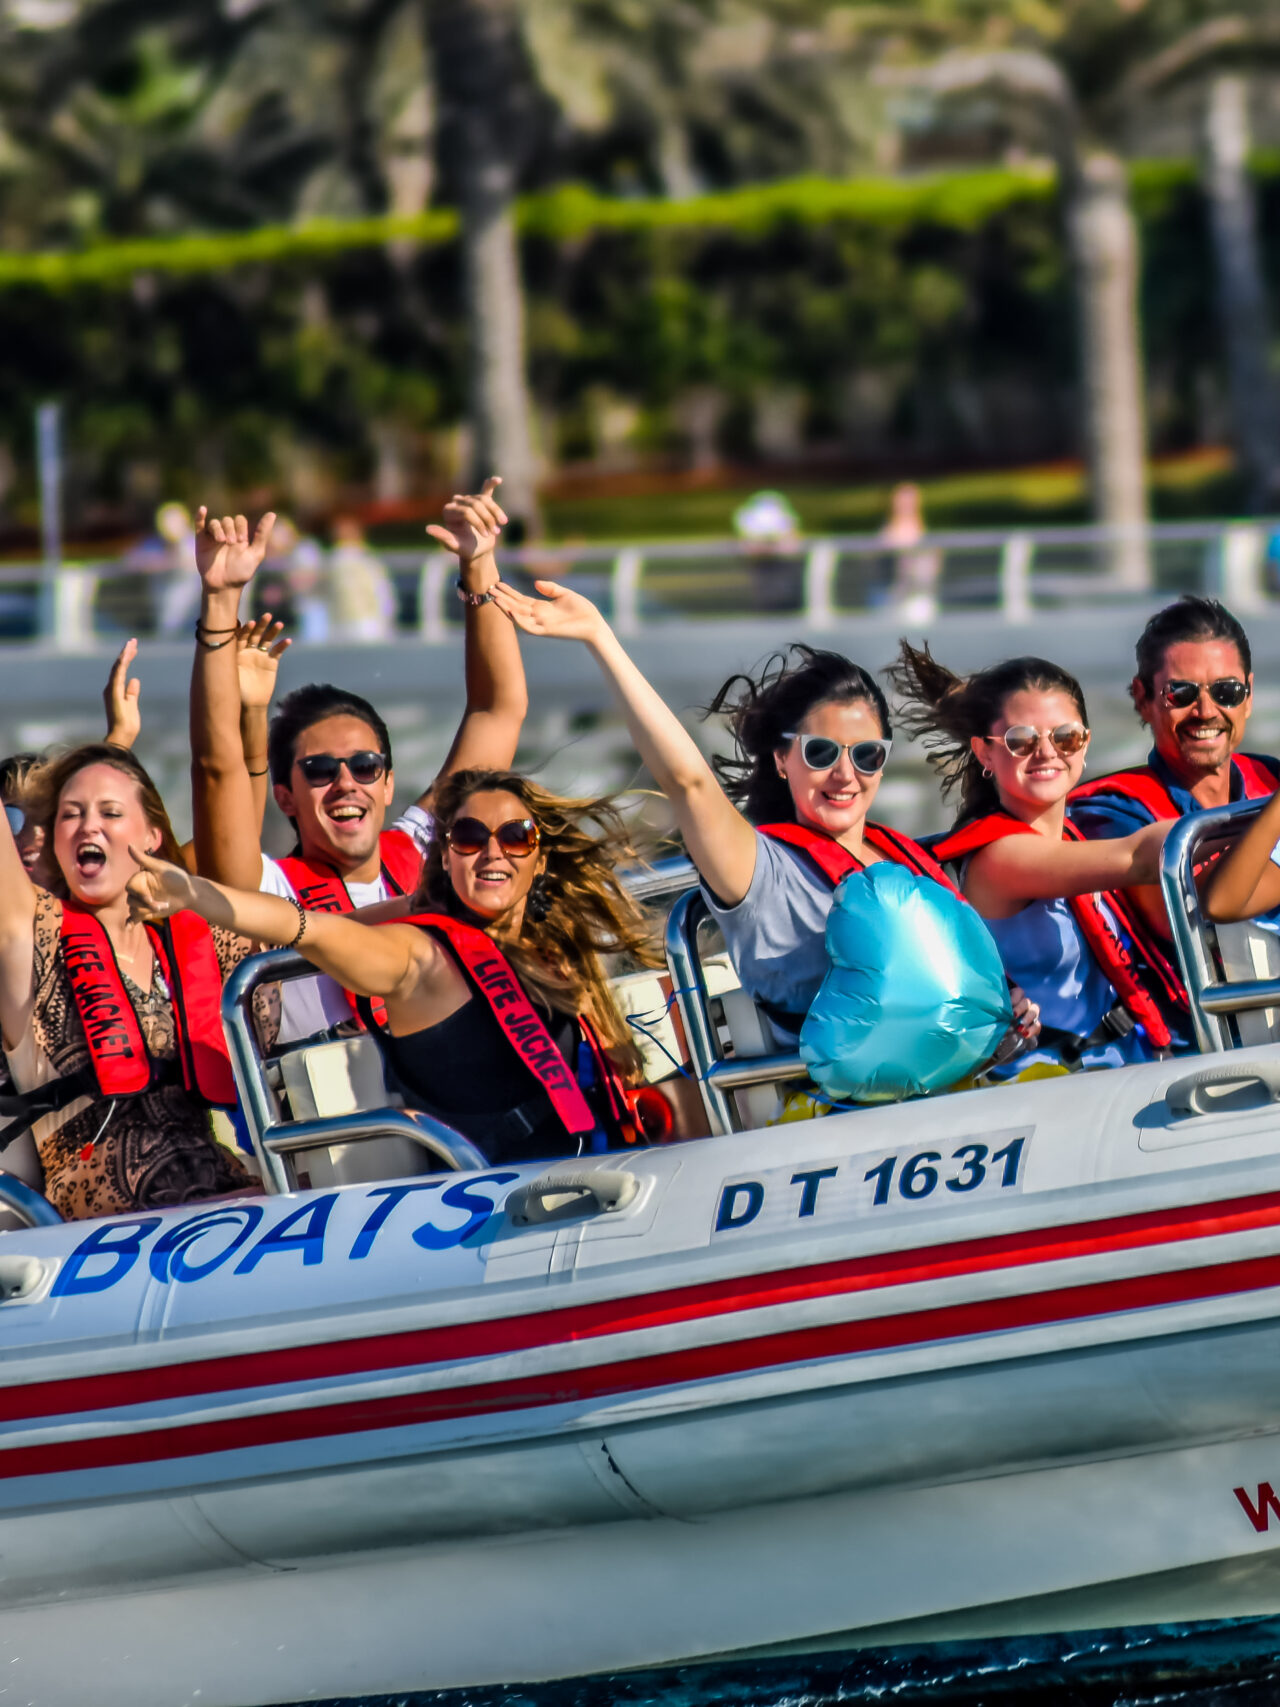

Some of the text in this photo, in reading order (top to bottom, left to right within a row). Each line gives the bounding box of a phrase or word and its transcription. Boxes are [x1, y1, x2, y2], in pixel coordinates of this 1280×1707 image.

[299, 883, 342, 912] LIF
[61, 932, 134, 1060] LIFE JACKET
[473, 958, 574, 1091] LIFE JACKET
[863, 1136, 1026, 1207] 1631
[49, 1172, 521, 1298] BOATS
